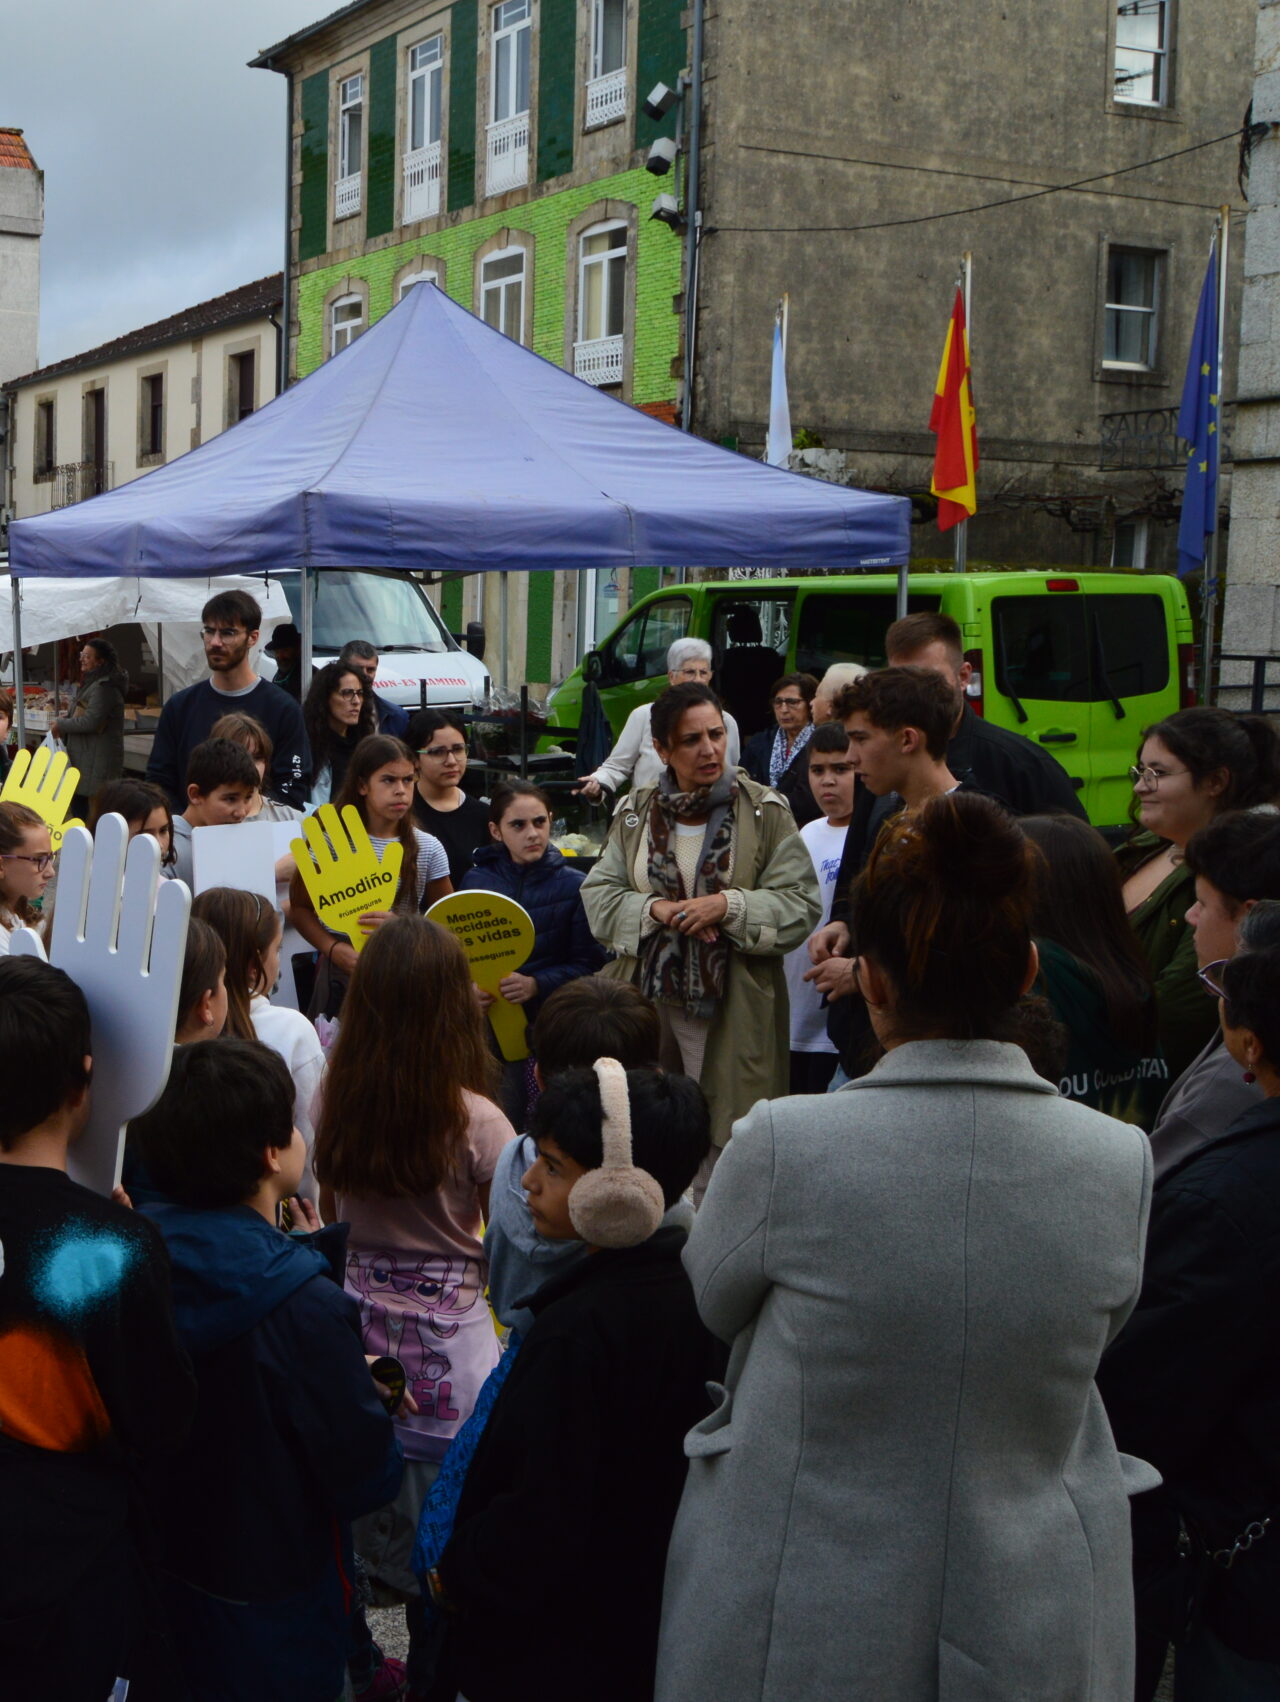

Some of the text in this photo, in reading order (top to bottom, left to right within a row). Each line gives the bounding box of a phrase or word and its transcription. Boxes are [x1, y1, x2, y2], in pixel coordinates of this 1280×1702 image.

[419, 678, 467, 686] AMIRO
[318, 871, 393, 910] Amodiño
[446, 908, 492, 925] Menos
[476, 927, 522, 944] vidas
[470, 949, 516, 963] asseguras
